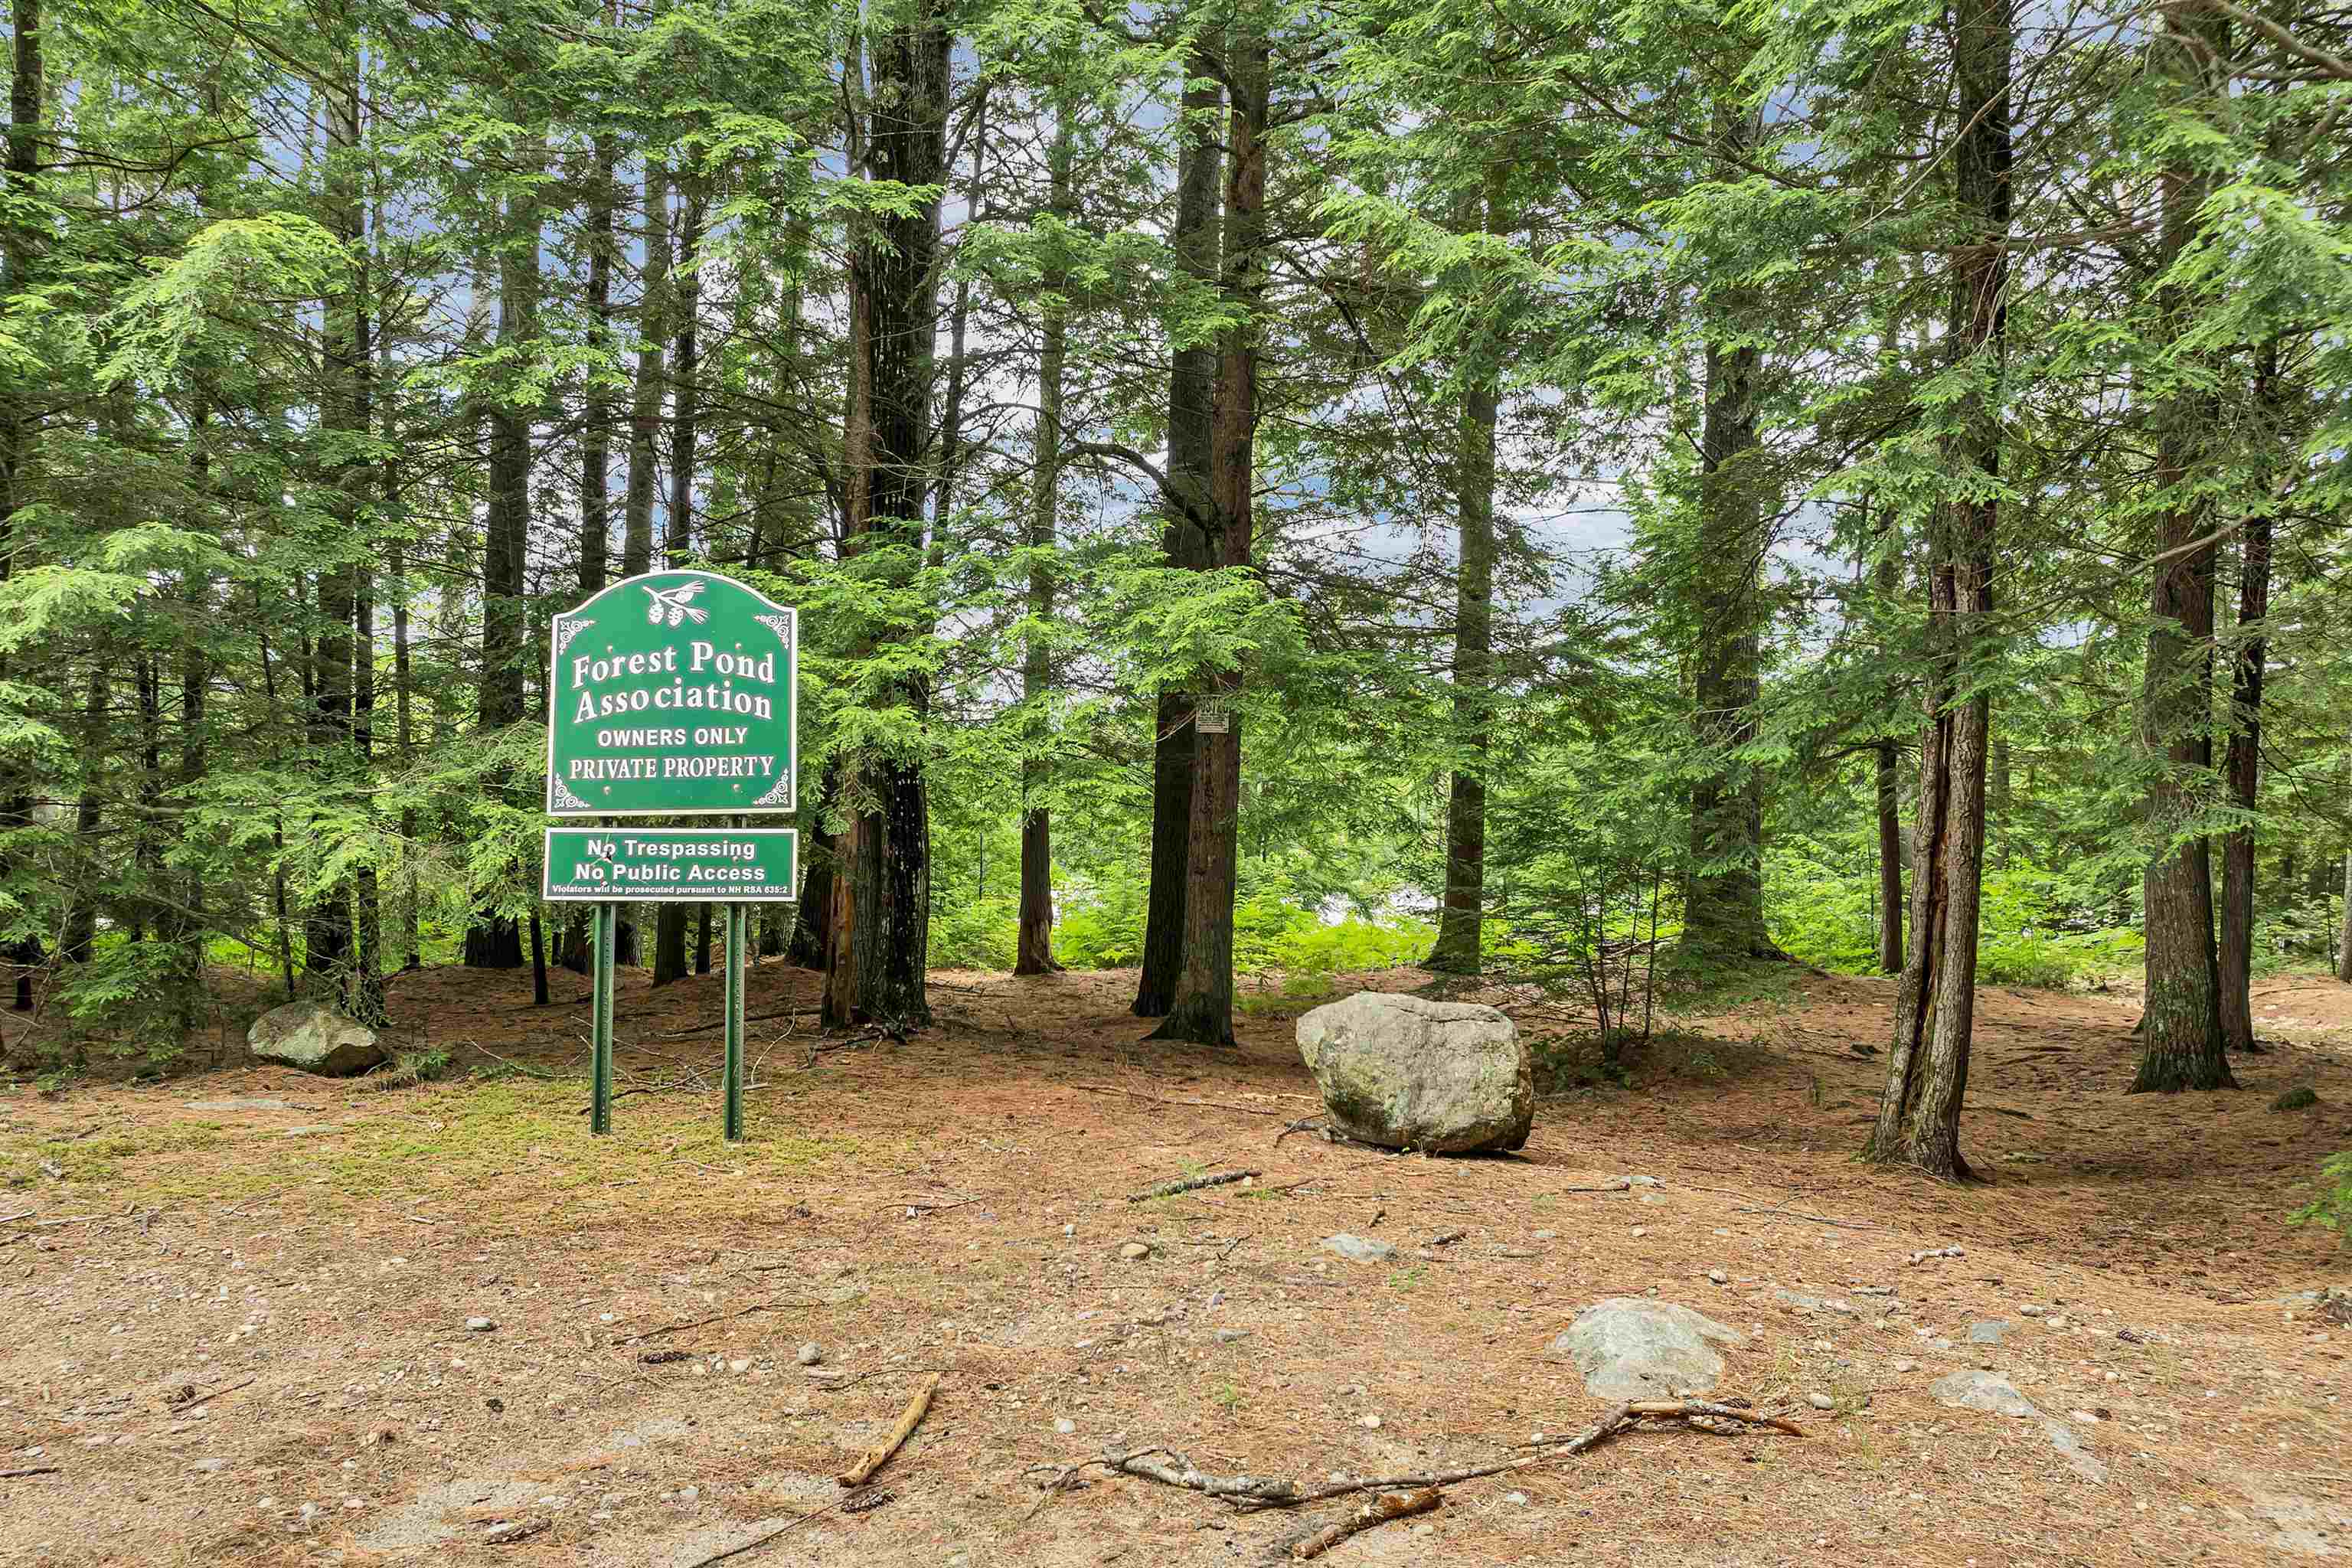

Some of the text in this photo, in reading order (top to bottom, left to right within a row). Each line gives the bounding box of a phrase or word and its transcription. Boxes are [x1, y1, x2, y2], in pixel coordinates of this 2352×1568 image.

[572, 642, 775, 688] Forest Pond
[573, 677, 773, 724] Association
[598, 727, 748, 747] OWNERS ONLY
[570, 756, 775, 779] PRIVATE PROPERTY
[587, 839, 756, 860] No Trespassing
[576, 864, 766, 880] No Public Access
[626, 885, 675, 894] prosecuted
[676, 886, 715, 894] pursuant
